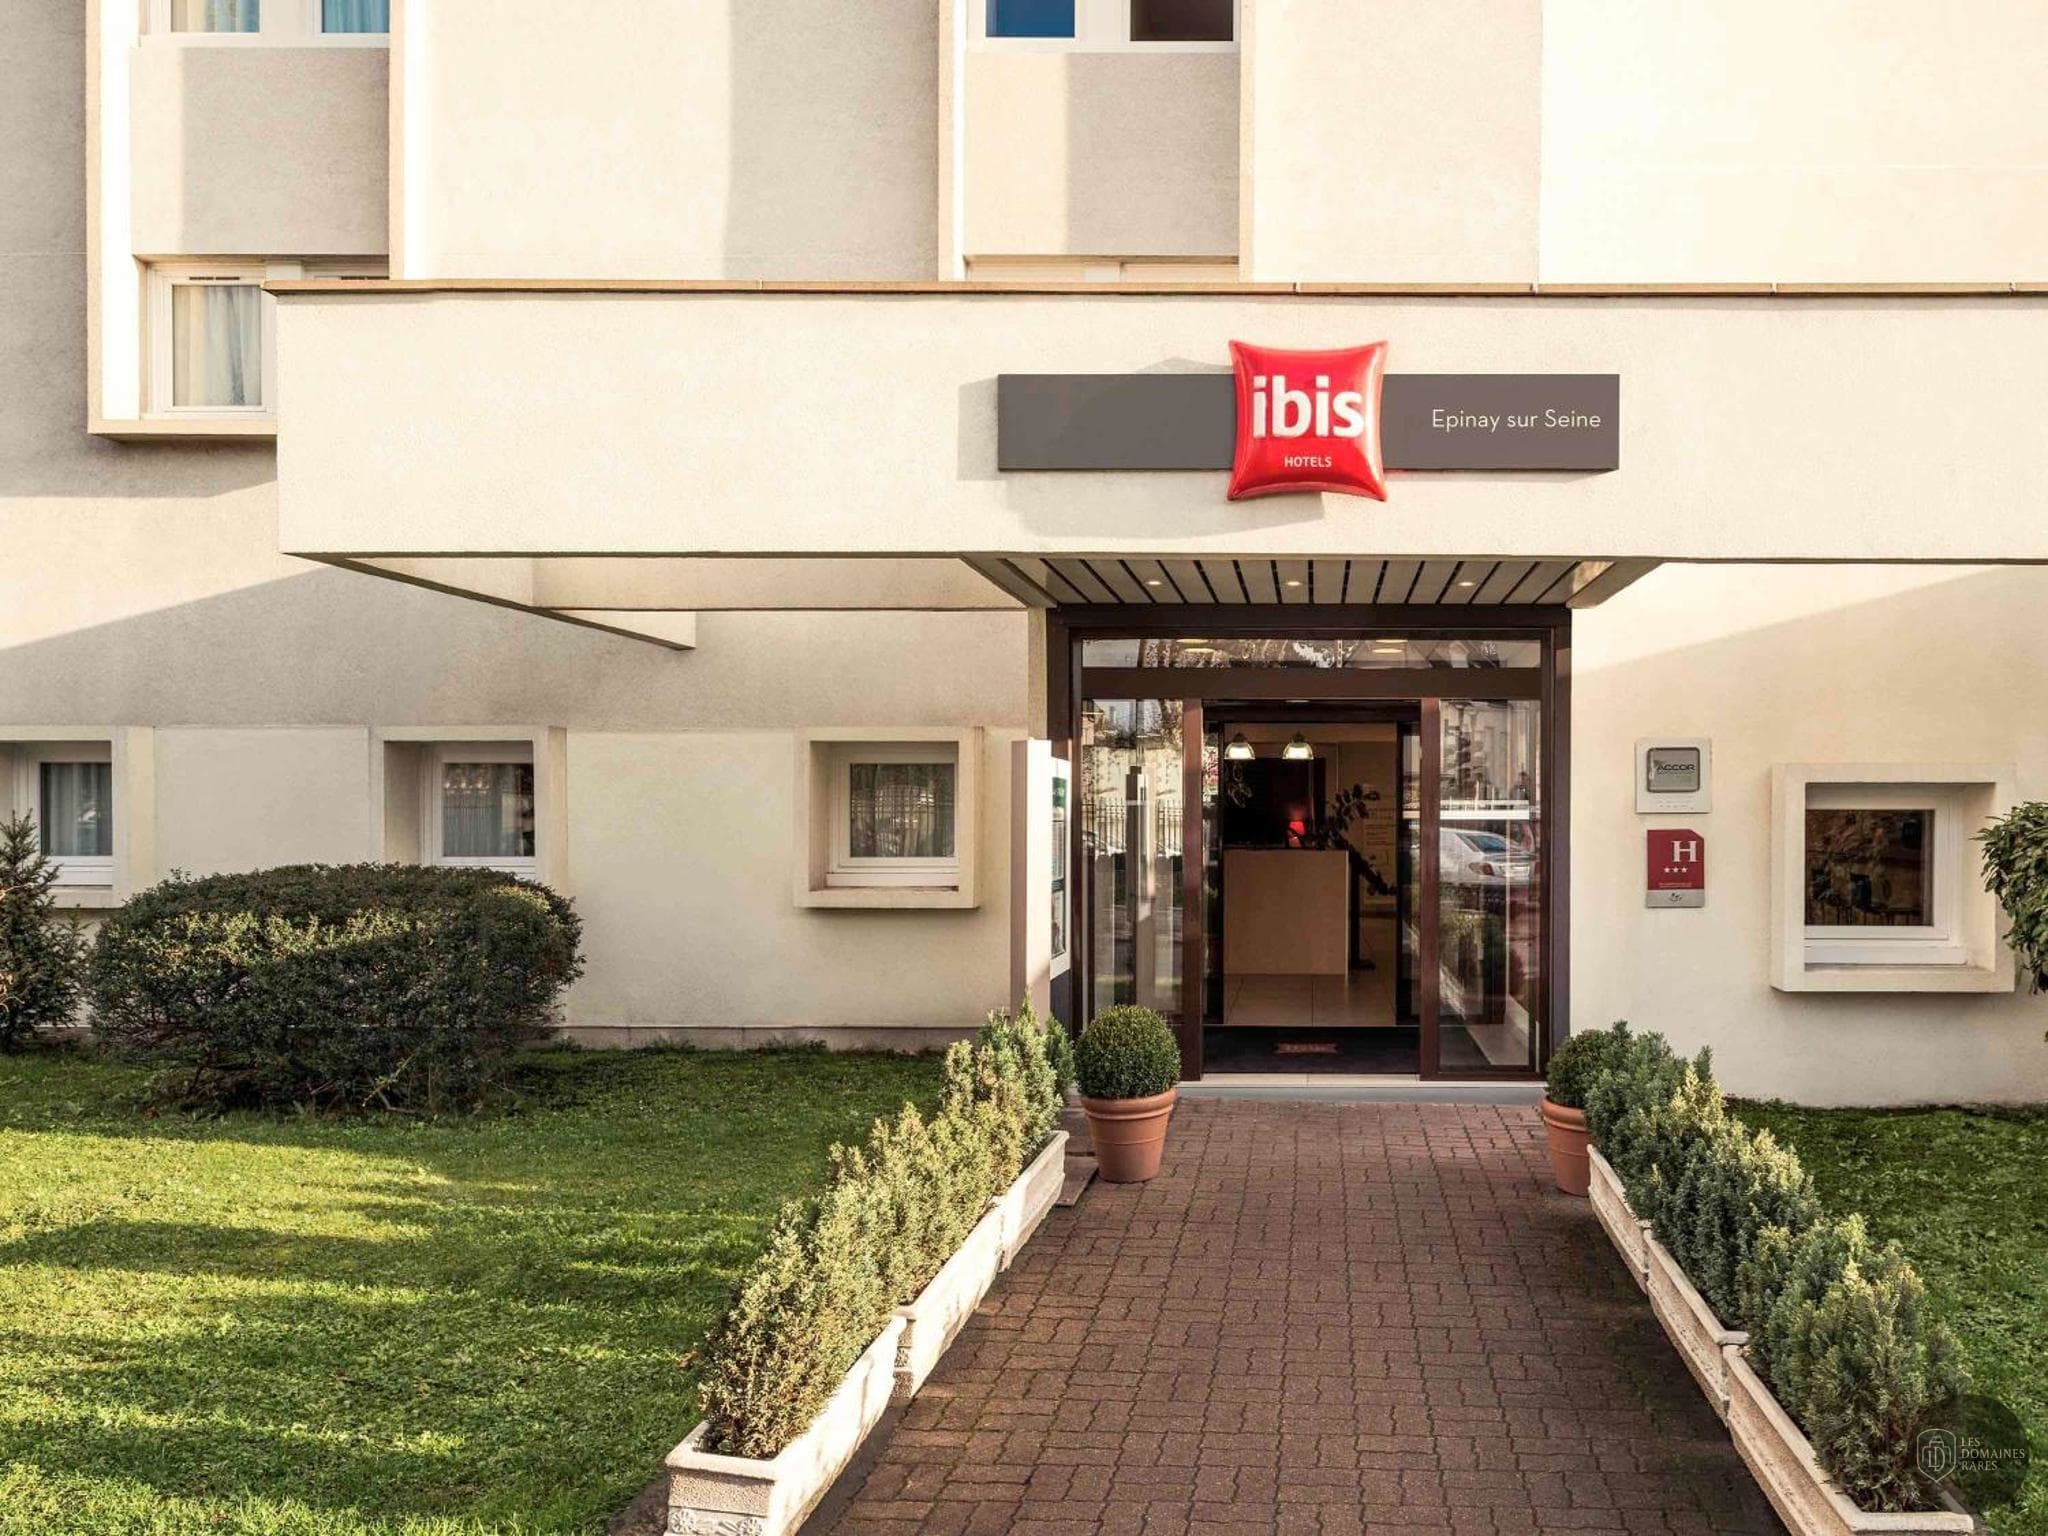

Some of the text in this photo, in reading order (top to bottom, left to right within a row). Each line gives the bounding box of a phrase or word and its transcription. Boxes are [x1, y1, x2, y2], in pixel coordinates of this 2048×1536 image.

[1252, 375, 1366, 439] ibis
[1432, 408, 1601, 434] Epinay sur Seine
[1284, 456, 1332, 468] HOTELS
[1656, 763, 1695, 772] ACCOR
[1672, 840, 1698, 862] H
